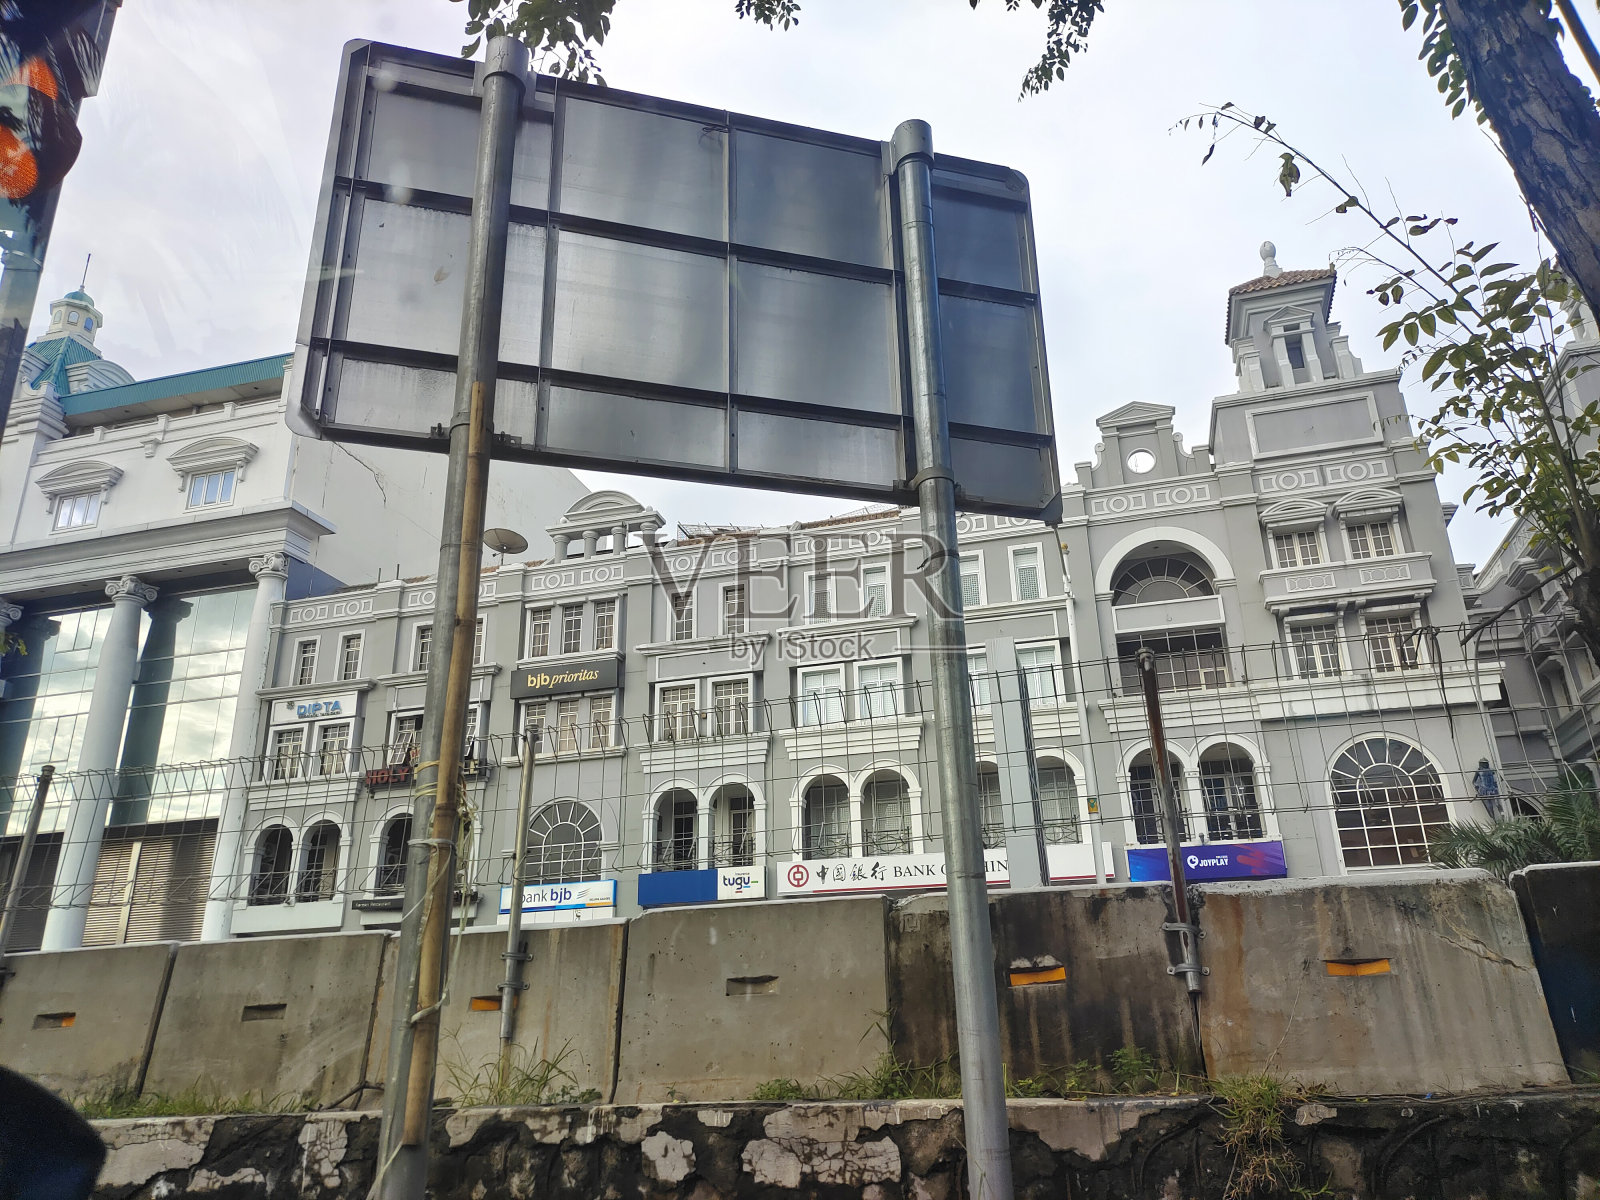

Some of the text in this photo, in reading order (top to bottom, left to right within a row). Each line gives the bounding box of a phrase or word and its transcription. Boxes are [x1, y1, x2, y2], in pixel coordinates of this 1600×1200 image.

[527, 669, 600, 689] bjb prioritas
[297, 700, 342, 716] DIPTA
[1199, 858, 1229, 867] JOYPLAY
[893, 864, 936, 878] BANK
[722, 875, 750, 890] tugu
[550, 887, 572, 904] bjb
